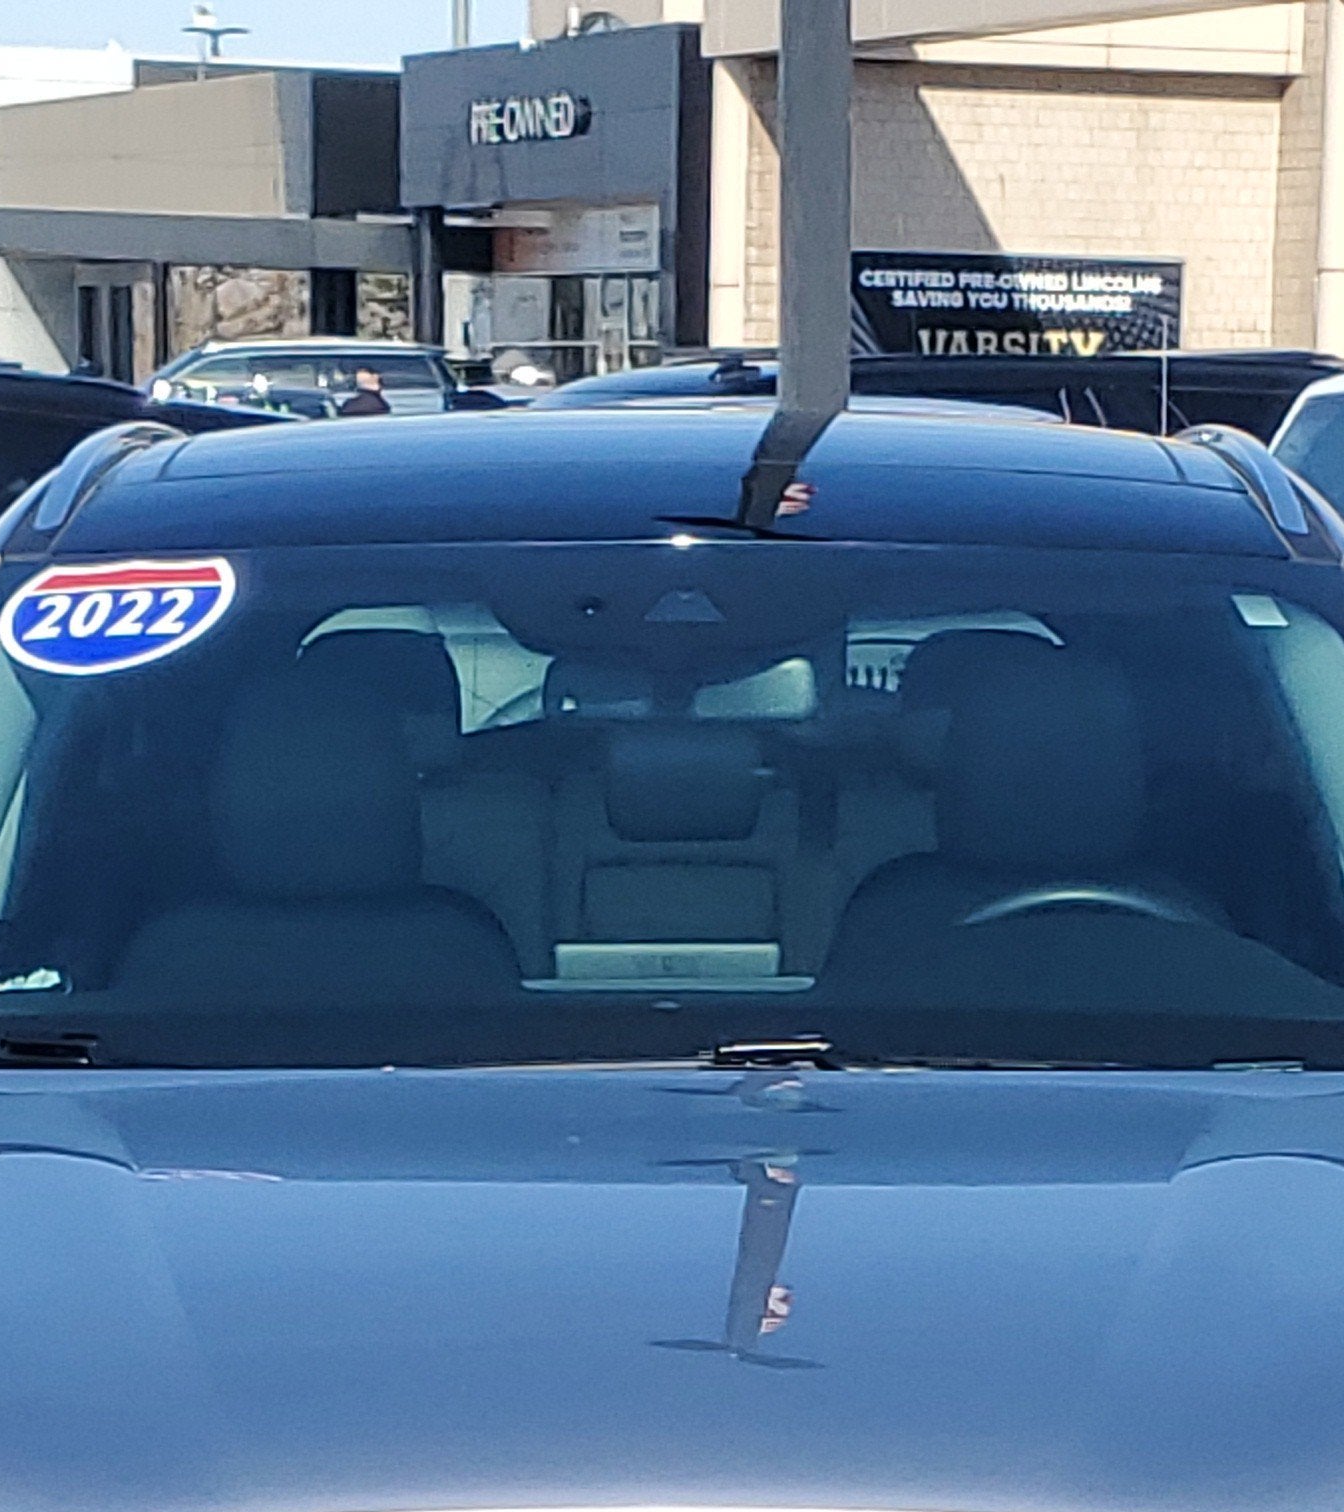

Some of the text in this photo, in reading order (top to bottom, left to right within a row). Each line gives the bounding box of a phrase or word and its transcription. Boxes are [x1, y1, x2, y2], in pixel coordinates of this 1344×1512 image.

[859, 270, 954, 288] CERTIFIED
[959, 272, 1067, 292] PRE-OWNED
[892, 291, 964, 308] SAVING
[967, 292, 1007, 309] YOU
[918, 329, 1105, 356] VARSITY
[22, 588, 194, 641] 2022
